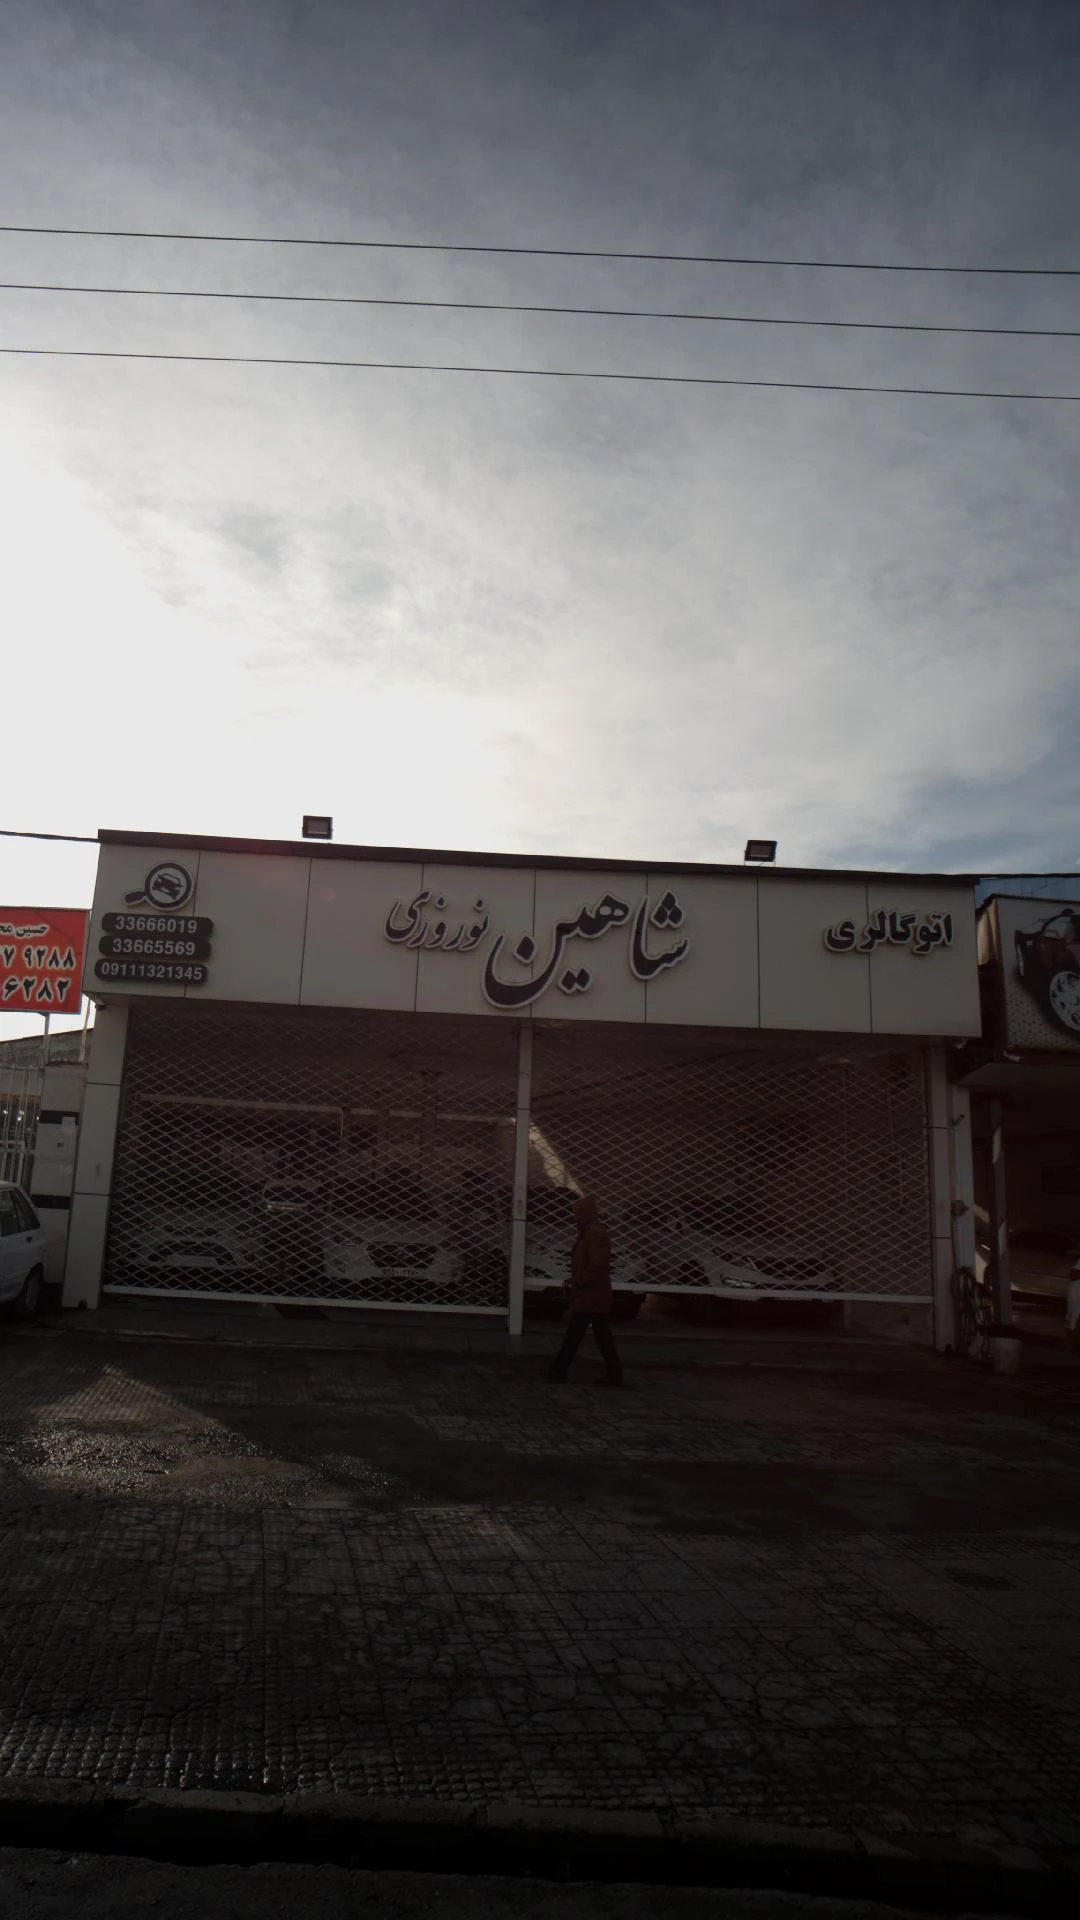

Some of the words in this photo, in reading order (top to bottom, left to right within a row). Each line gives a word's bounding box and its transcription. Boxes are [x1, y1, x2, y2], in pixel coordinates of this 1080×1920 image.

[115, 916, 198, 934] 33666019
[383, 888, 491, 951] نوروزی
[112, 938, 196, 956] 33665569
[484, 888, 690, 1009] شاهین
[100, 961, 203, 981] 09111321345
